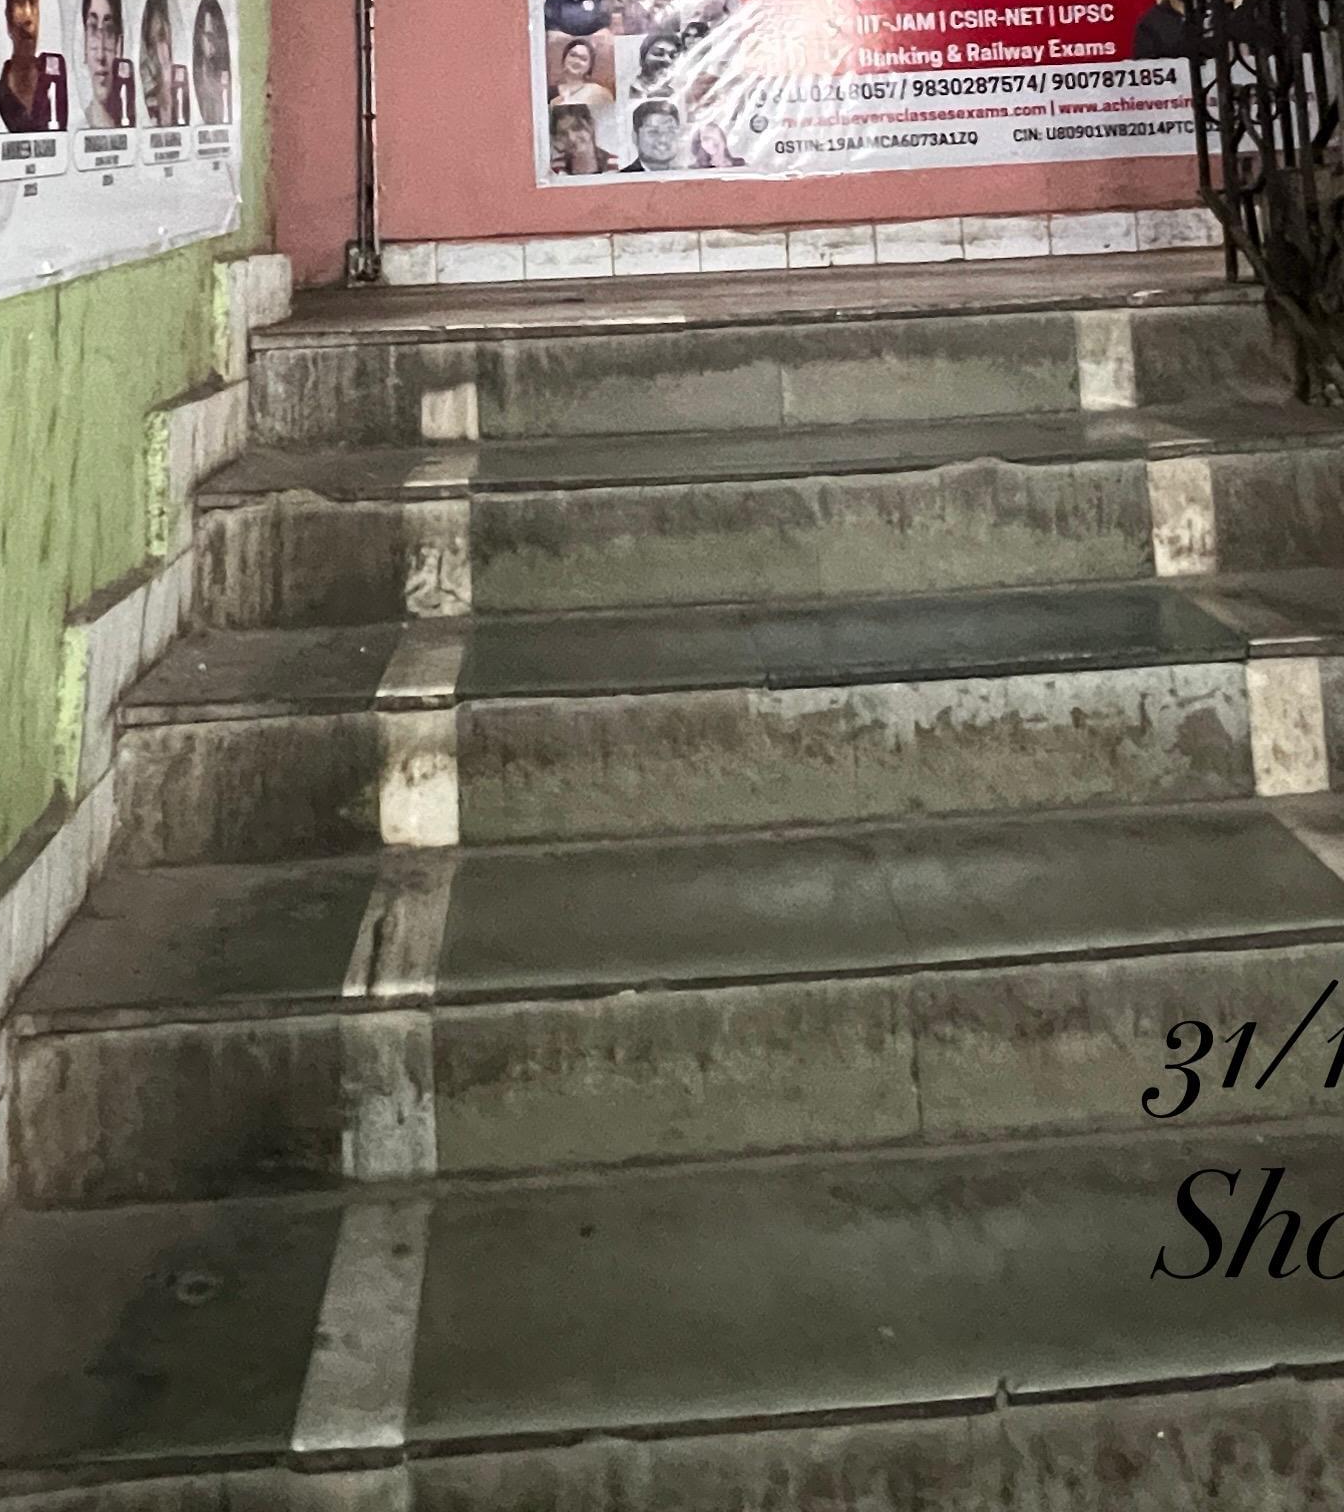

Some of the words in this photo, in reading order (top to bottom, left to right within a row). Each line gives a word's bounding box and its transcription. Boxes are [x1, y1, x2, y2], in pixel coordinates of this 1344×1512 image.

[857, 11, 936, 34] IIT-JAM
[949, 6, 1045, 30] CSIR-NET
[1058, 3, 1115, 26] UPSC
[858, 45, 944, 69] Banking
[946, 44, 963, 63] &
[965, 42, 1044, 65] Railway
[1048, 38, 1117, 59] Exams
[1051, 67, 1177, 91] 9007871854
[47, 80, 60, 130] 1
